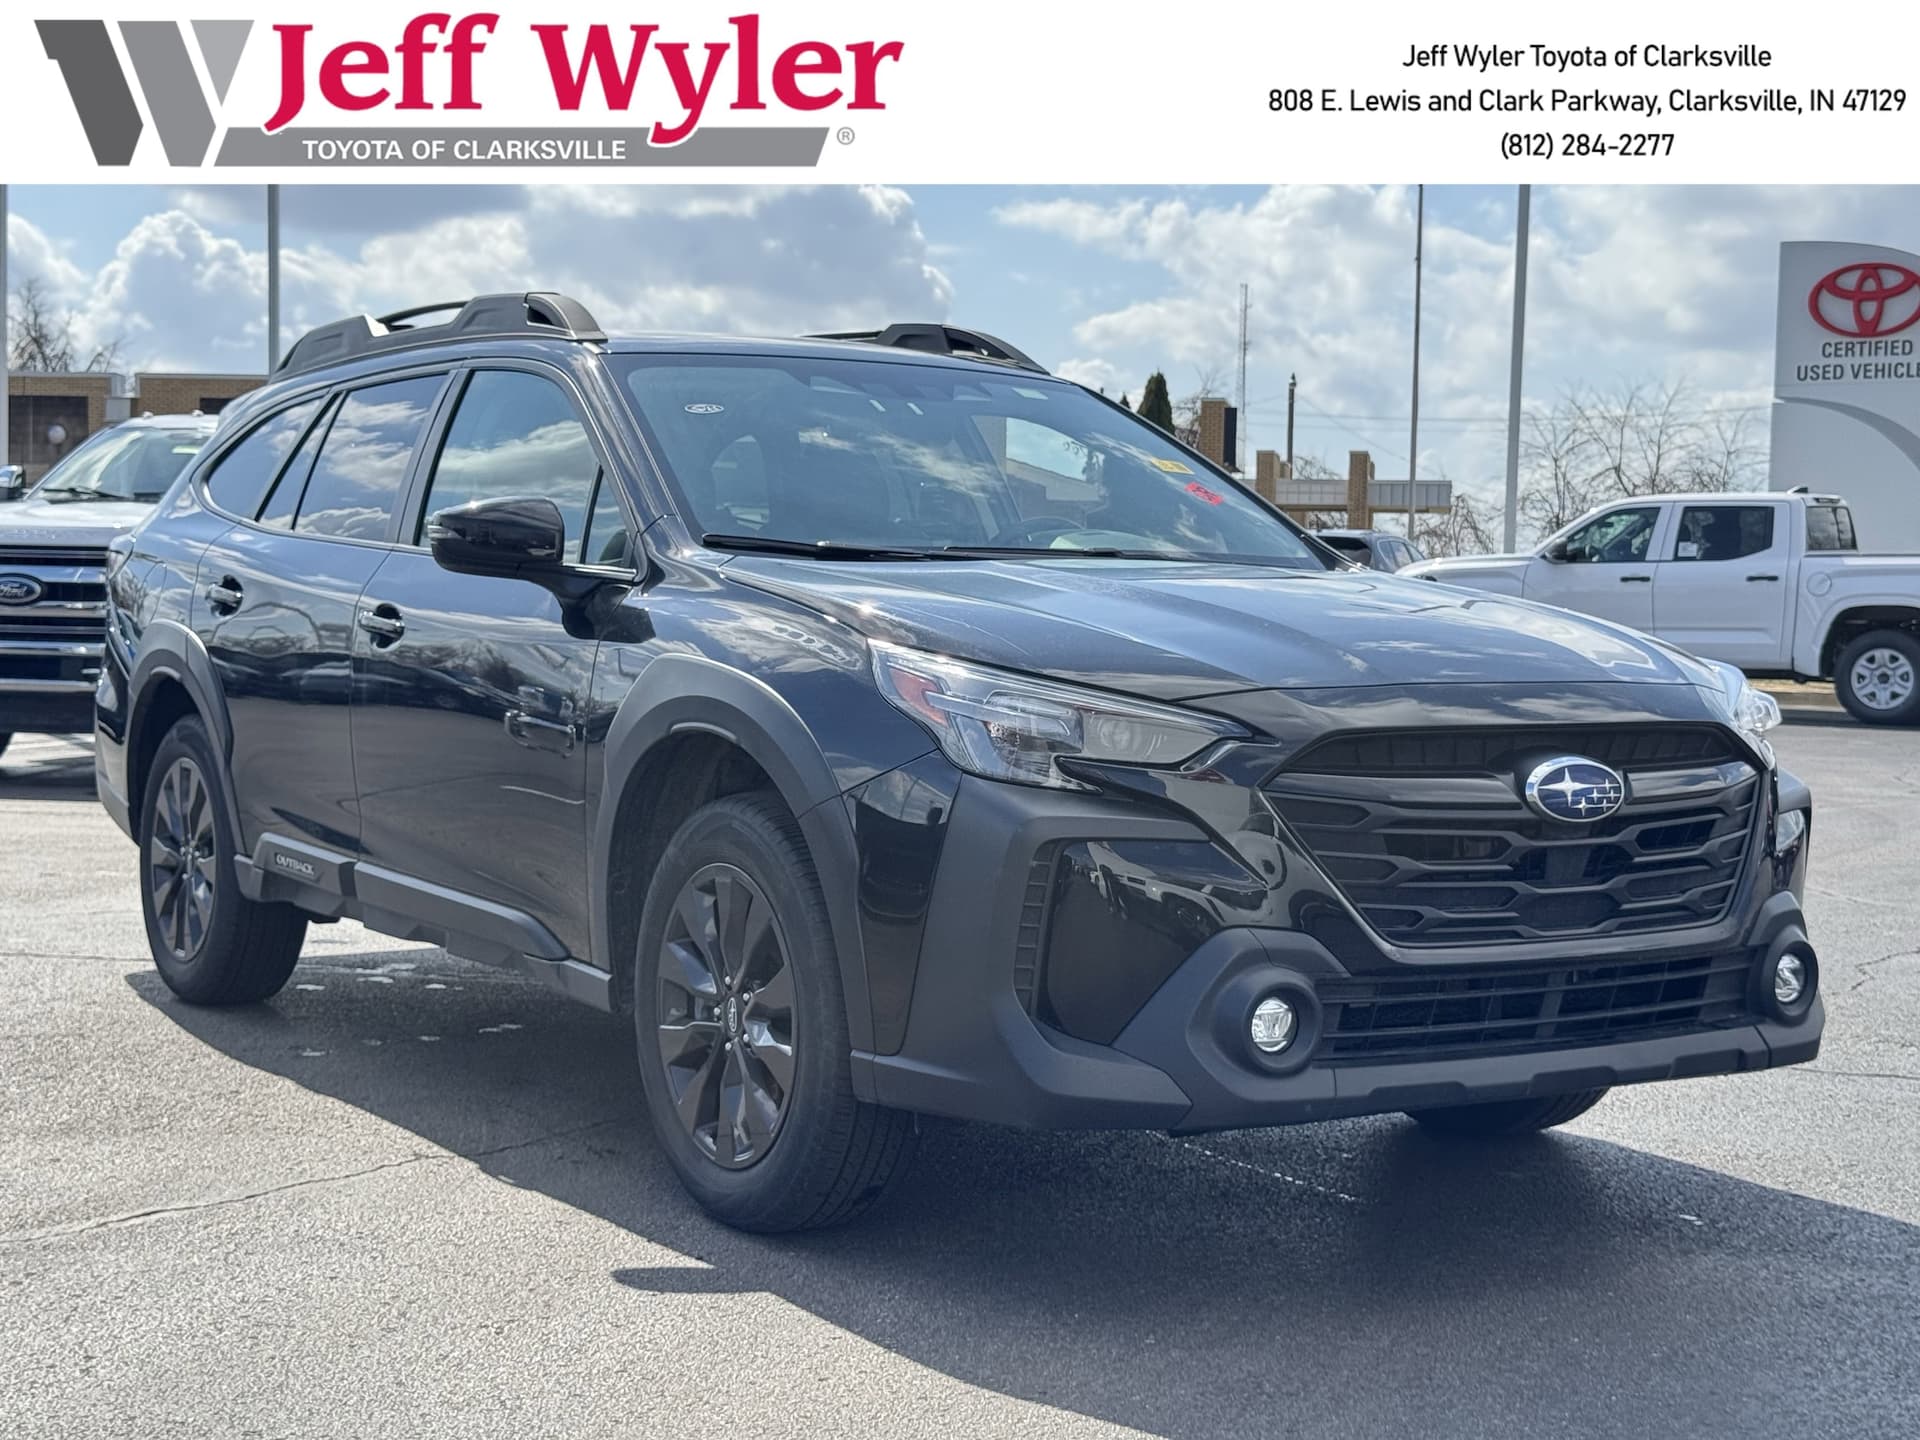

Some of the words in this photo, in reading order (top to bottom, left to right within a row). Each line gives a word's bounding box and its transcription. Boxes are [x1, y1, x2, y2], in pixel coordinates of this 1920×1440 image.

[1822, 340, 1913, 358] CERTIFIED
[1797, 364, 1844, 381] USED
[276, 854, 314, 875] OUTBACK
